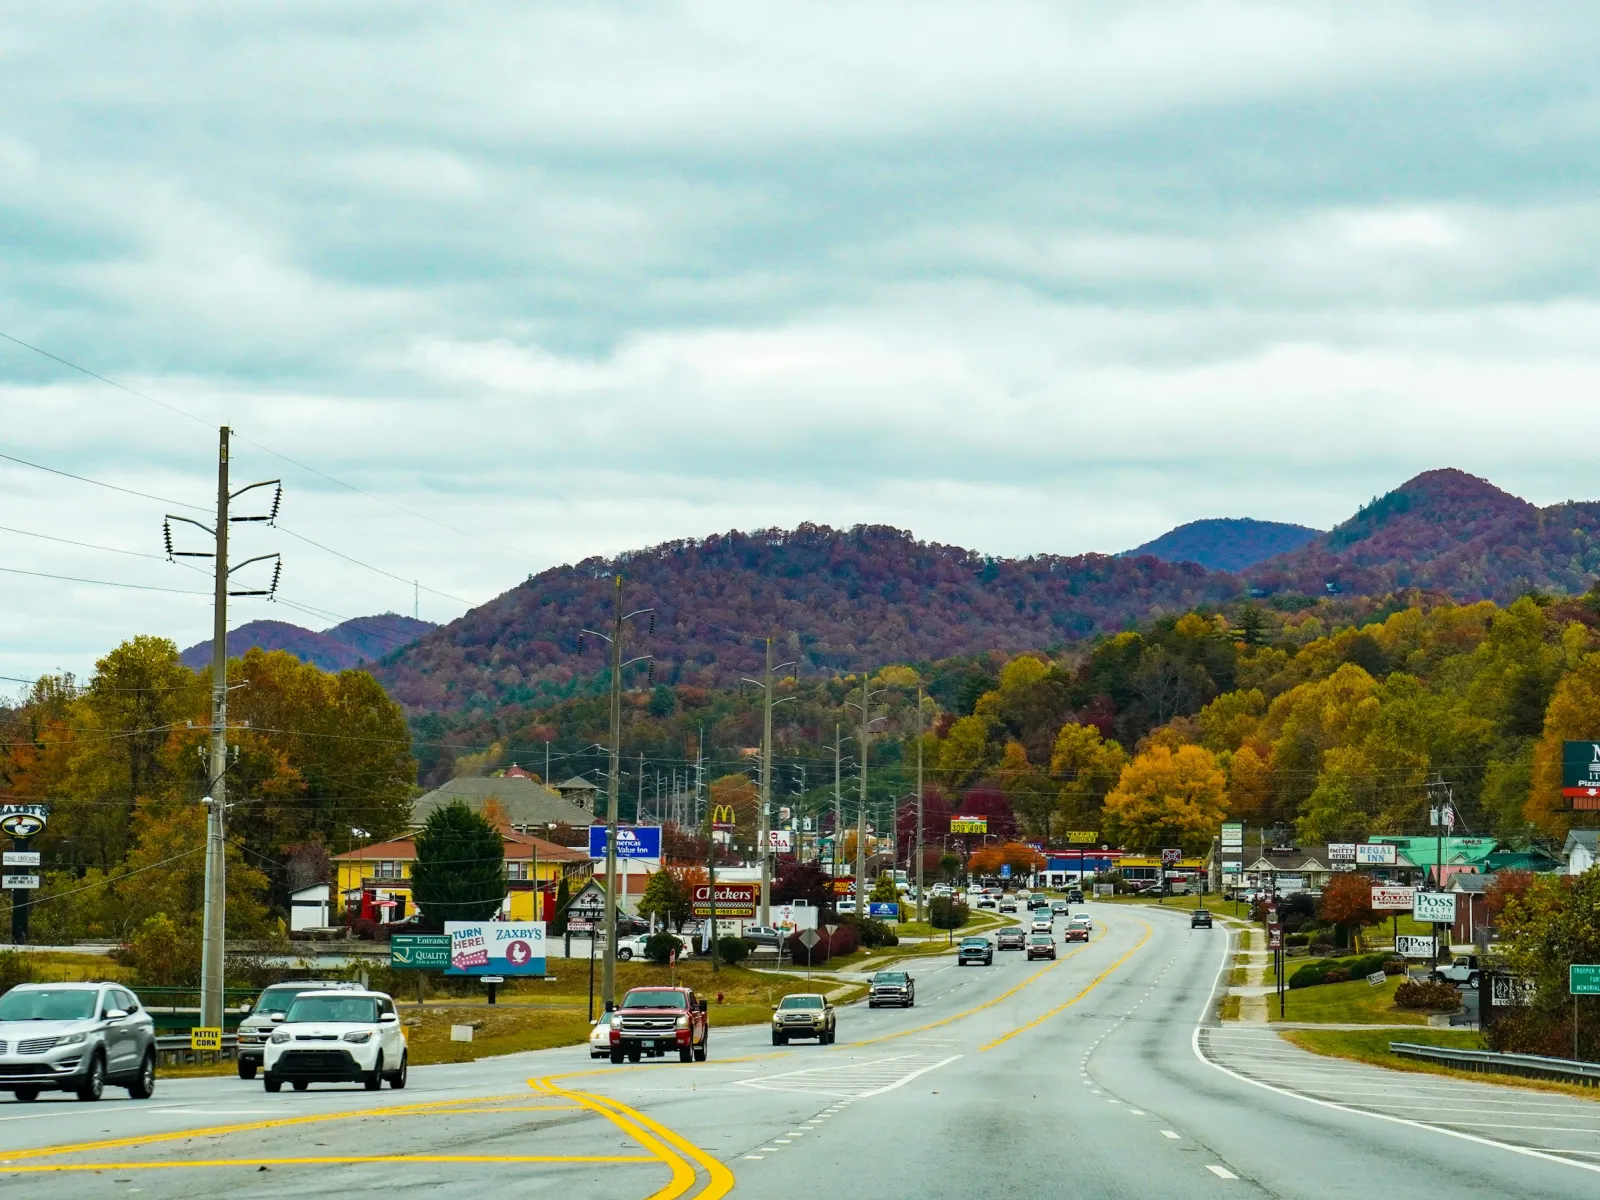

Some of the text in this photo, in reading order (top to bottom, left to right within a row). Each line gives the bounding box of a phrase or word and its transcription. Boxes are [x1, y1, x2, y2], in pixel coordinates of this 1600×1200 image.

[1359, 846, 1393, 854] REGAL
[1367, 854, 1385, 862] INN
[453, 928, 482, 940] TURN
[496, 928, 542, 940] ZAXBY'S
[453, 937, 485, 950] HERE!
[415, 951, 448, 960] QUALITY
[196, 1039, 217, 1047] CORN
